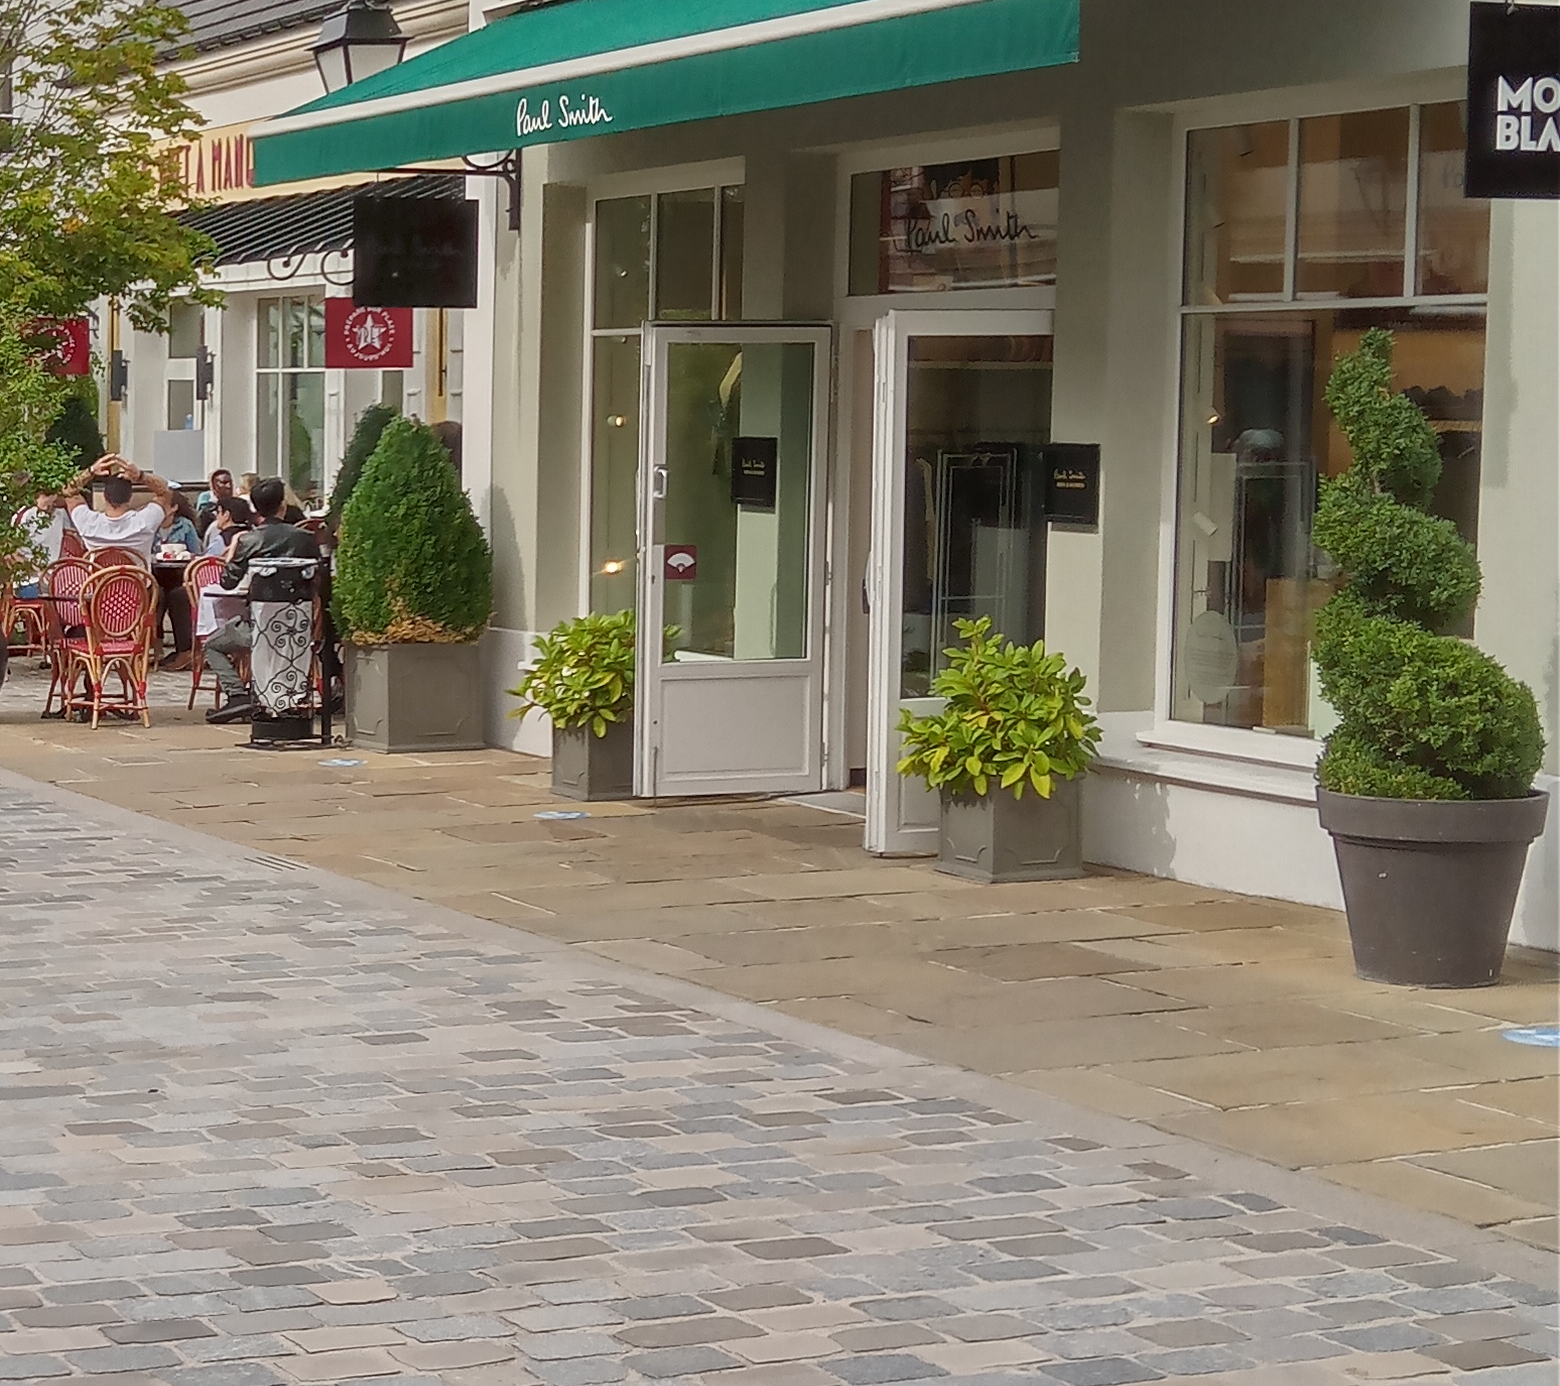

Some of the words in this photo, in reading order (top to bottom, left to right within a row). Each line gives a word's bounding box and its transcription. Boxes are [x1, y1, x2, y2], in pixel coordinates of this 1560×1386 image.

[516, 98, 552, 137] Paul
[558, 93, 613, 128] Smith
[196, 140, 205, 194] A
[905, 213, 957, 250] Paul
[964, 208, 1038, 243] Smith
